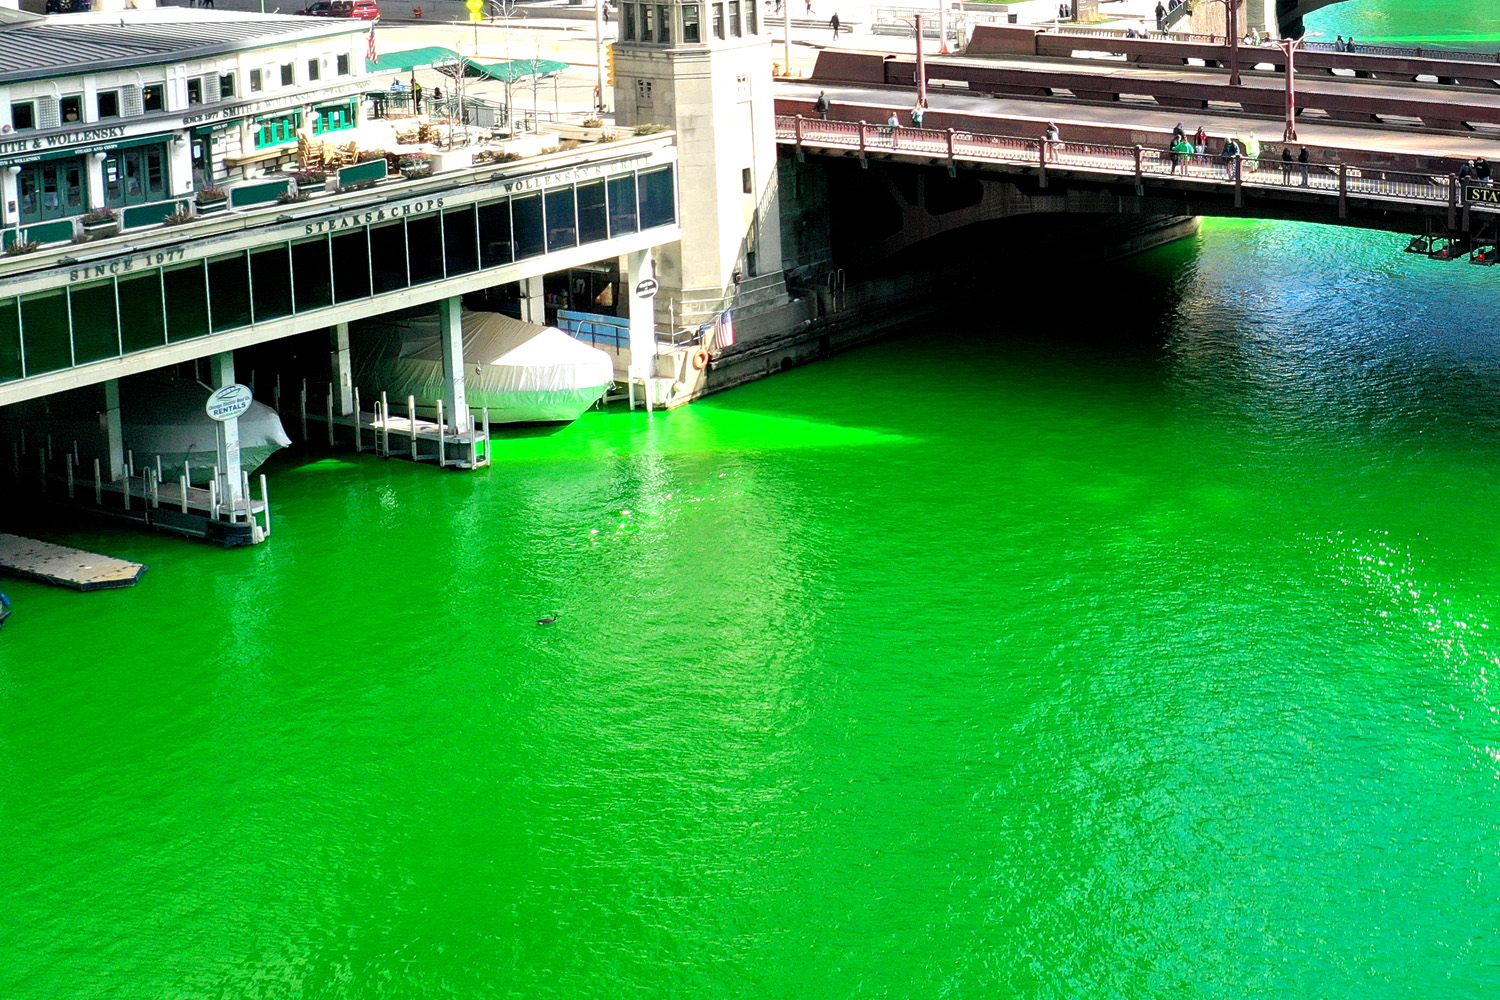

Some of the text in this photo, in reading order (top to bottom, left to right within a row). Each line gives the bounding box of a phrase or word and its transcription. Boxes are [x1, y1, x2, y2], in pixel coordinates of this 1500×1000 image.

[222, 104, 252, 118] SMITH
[32, 138, 42, 149] &
[47, 126, 126, 147] WOLLENSKY
[503, 167, 590, 193] WOLLENSKY
[610, 158, 650, 172] GRILL
[69, 248, 187, 282] SINCE 1977
[213, 402, 246, 416] RENTALS
